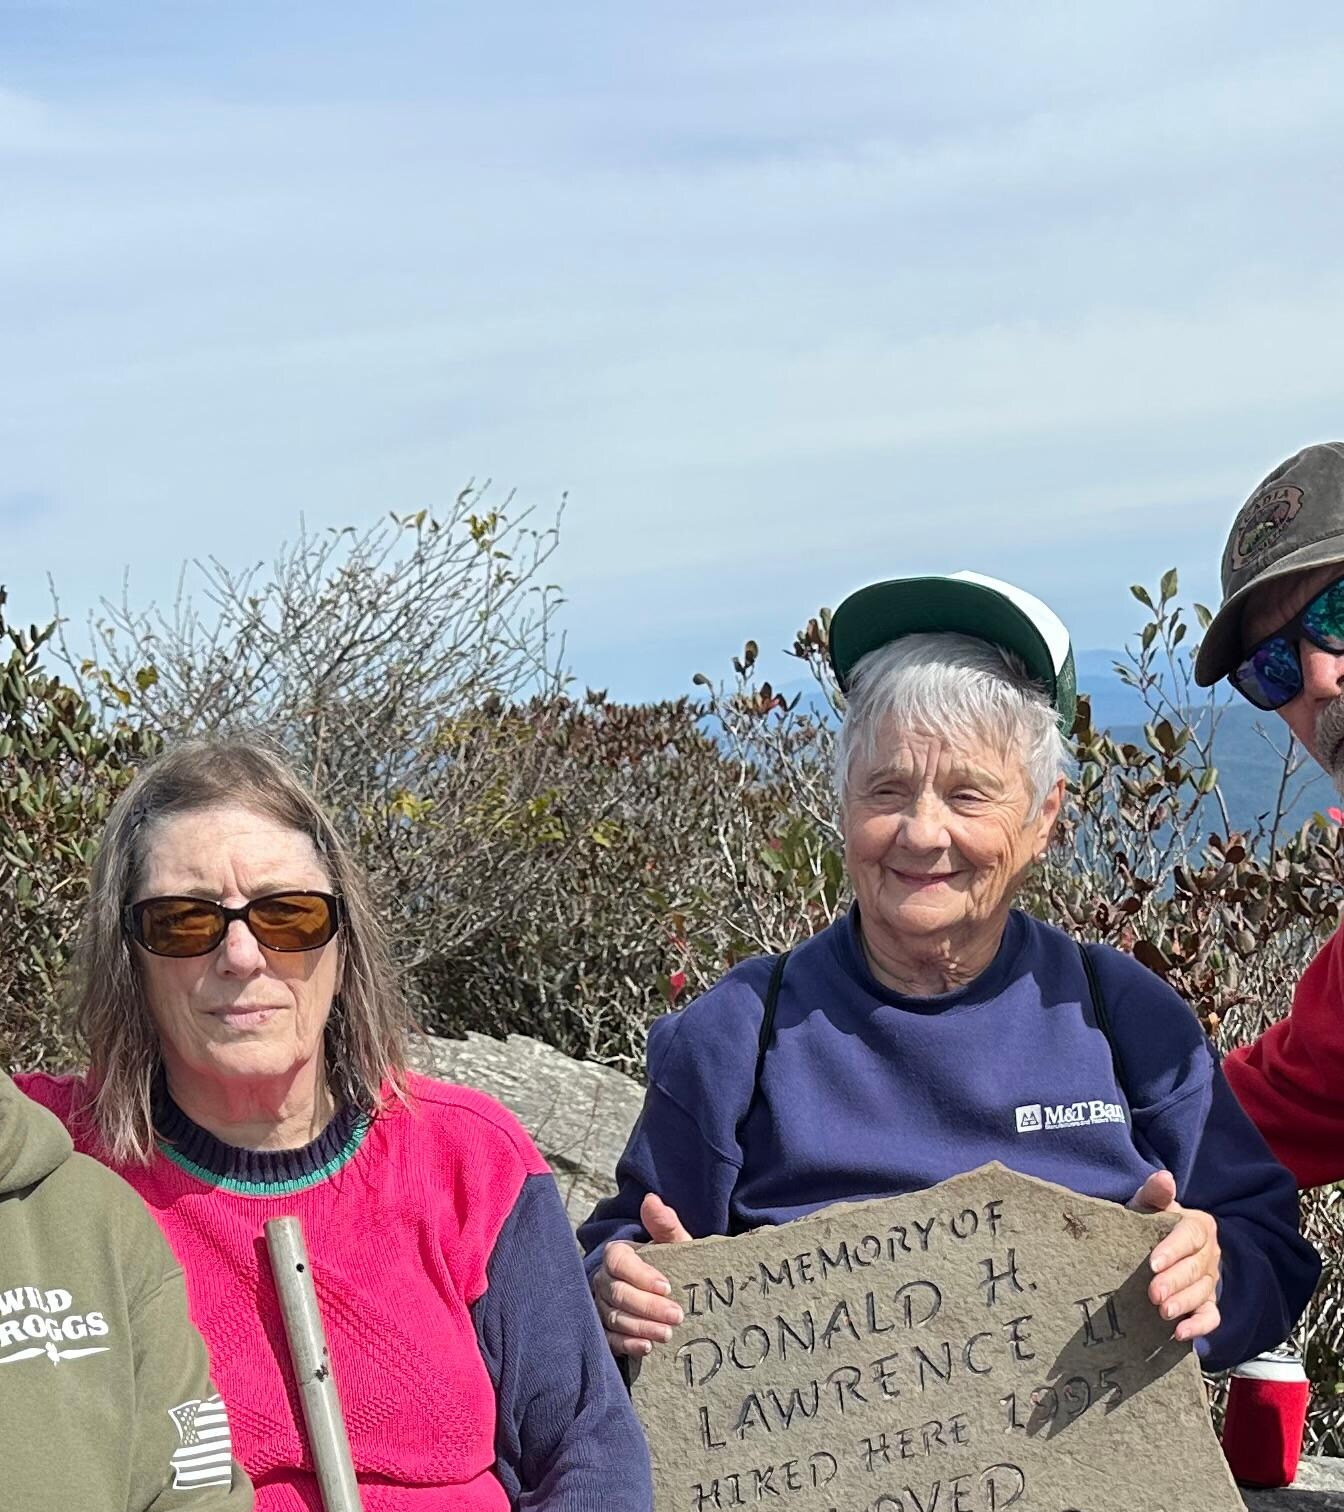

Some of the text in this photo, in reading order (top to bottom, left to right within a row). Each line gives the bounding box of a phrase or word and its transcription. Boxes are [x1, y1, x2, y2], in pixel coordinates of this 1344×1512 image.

[950, 1200, 1004, 1239] OF
[674, 1280, 942, 1387] DONALD
[698, 1289, 1128, 1451] LAWRENCE II
[859, 1412, 971, 1472] HERE
